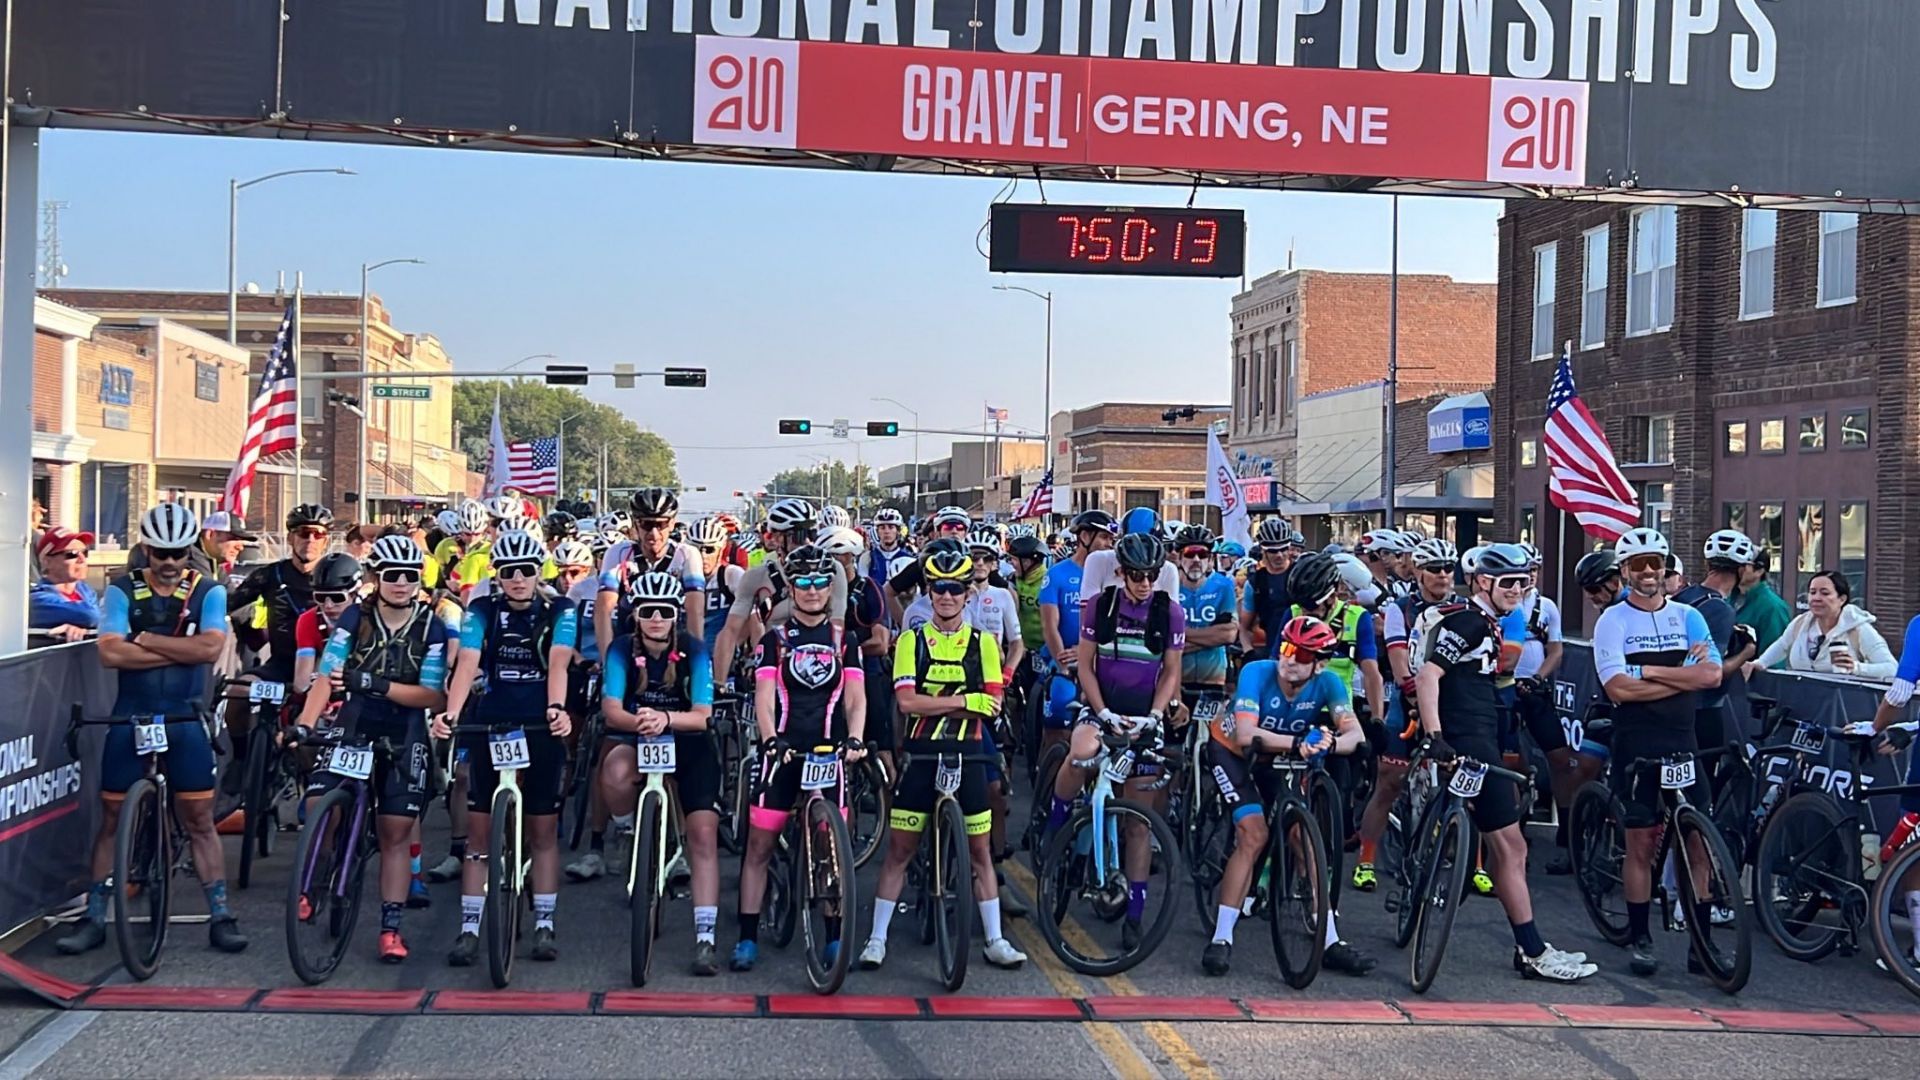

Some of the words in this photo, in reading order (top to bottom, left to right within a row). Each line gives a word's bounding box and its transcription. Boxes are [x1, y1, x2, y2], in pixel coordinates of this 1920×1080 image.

[903, 64, 1068, 149] GRAVEL
[1093, 94, 1303, 148] GERING,
[1321, 104, 1389, 145] NE
[1058, 215, 1217, 263] 7:50:13
[376, 388, 386, 396] O
[391, 389, 427, 397] STREET
[1430, 420, 1461, 440] BAGELS
[254, 683, 282, 698] 981
[1198, 702, 1219, 716] 950
[1261, 715, 1306, 732] BLG
[339, 751, 366, 771] 931
[495, 741, 523, 762] 934
[643, 745, 670, 764] 935
[805, 763, 835, 782] 1078
[1665, 763, 1691, 783] 989
[1212, 765, 1241, 804] SDBC
